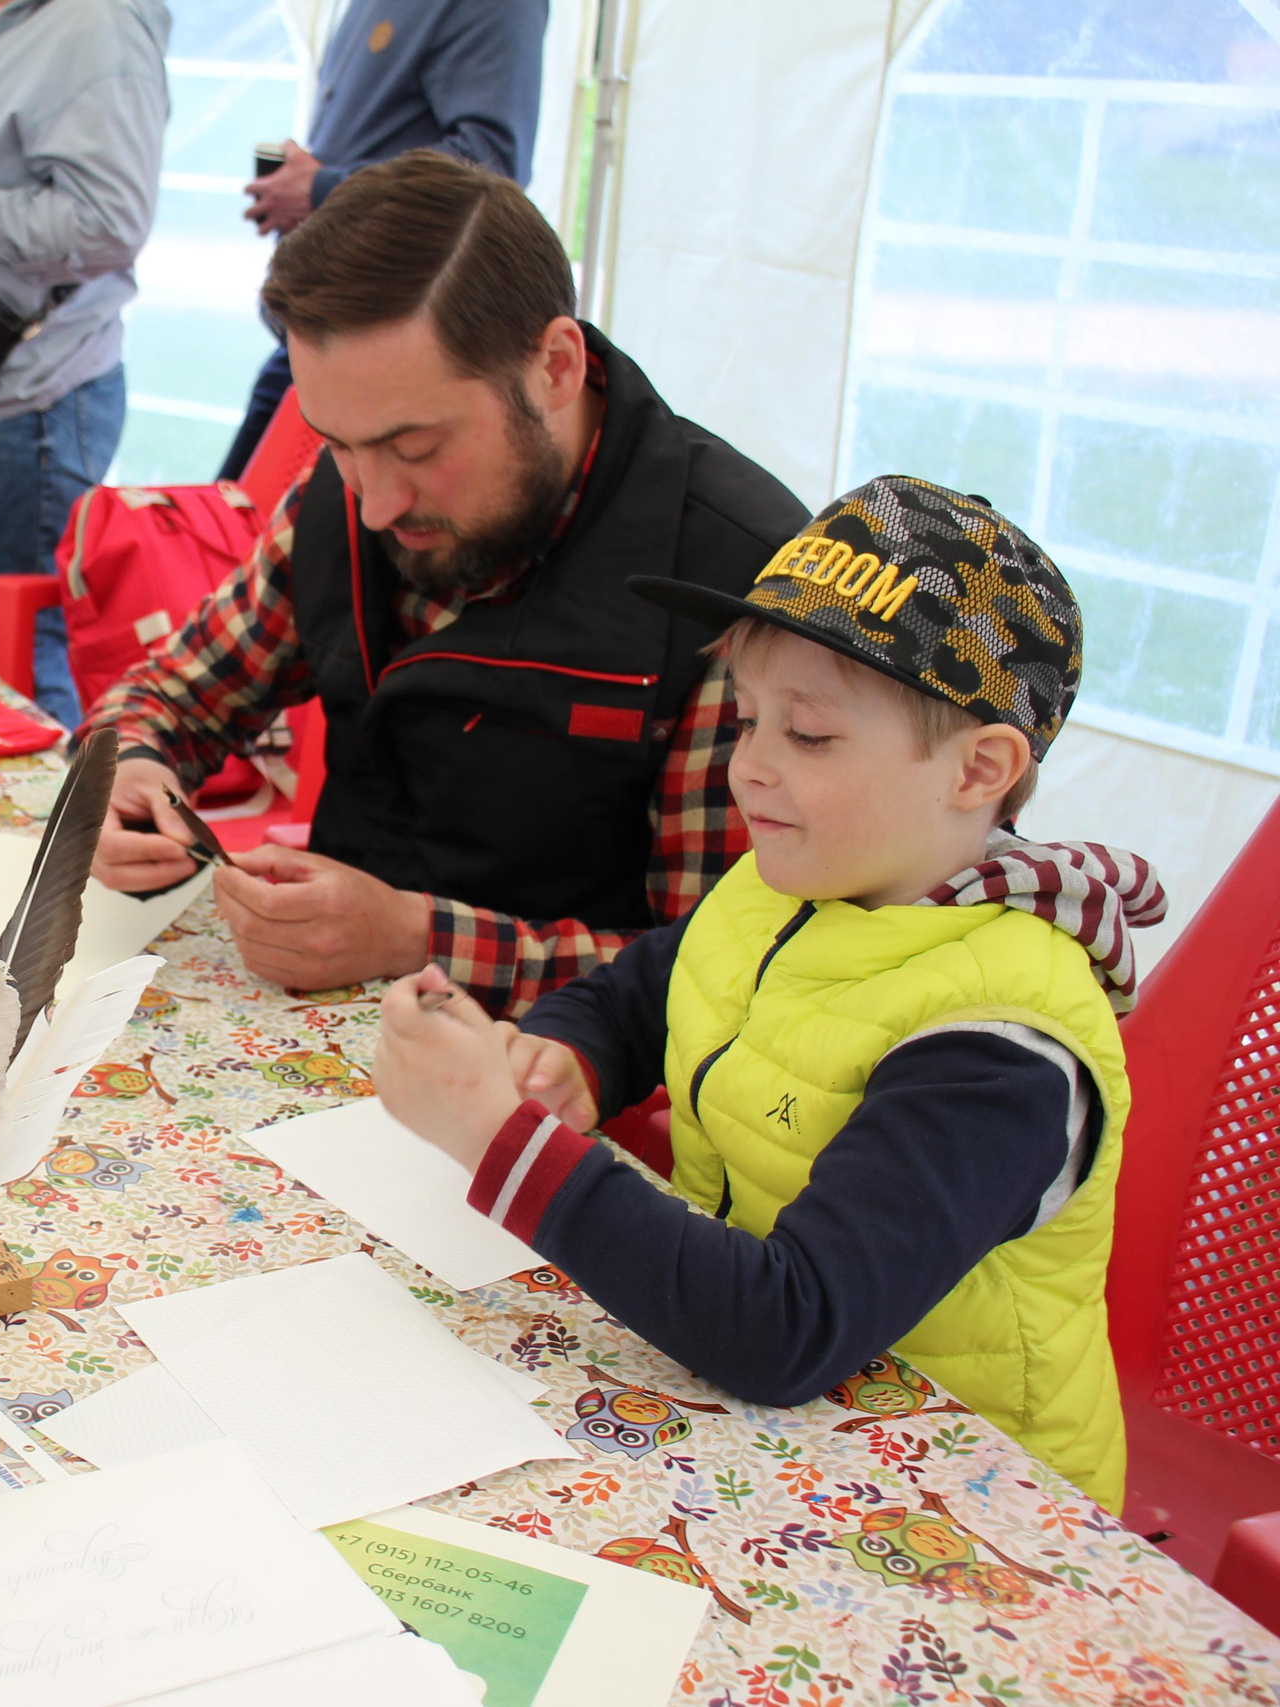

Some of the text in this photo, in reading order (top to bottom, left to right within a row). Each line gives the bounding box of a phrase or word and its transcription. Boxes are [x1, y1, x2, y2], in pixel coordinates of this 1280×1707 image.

[336, 1533, 534, 1596] +7 (915) 112-05-46
[368, 1563, 475, 1601] Сбербанк
[364, 1581, 526, 1639] 013 1607 8209
